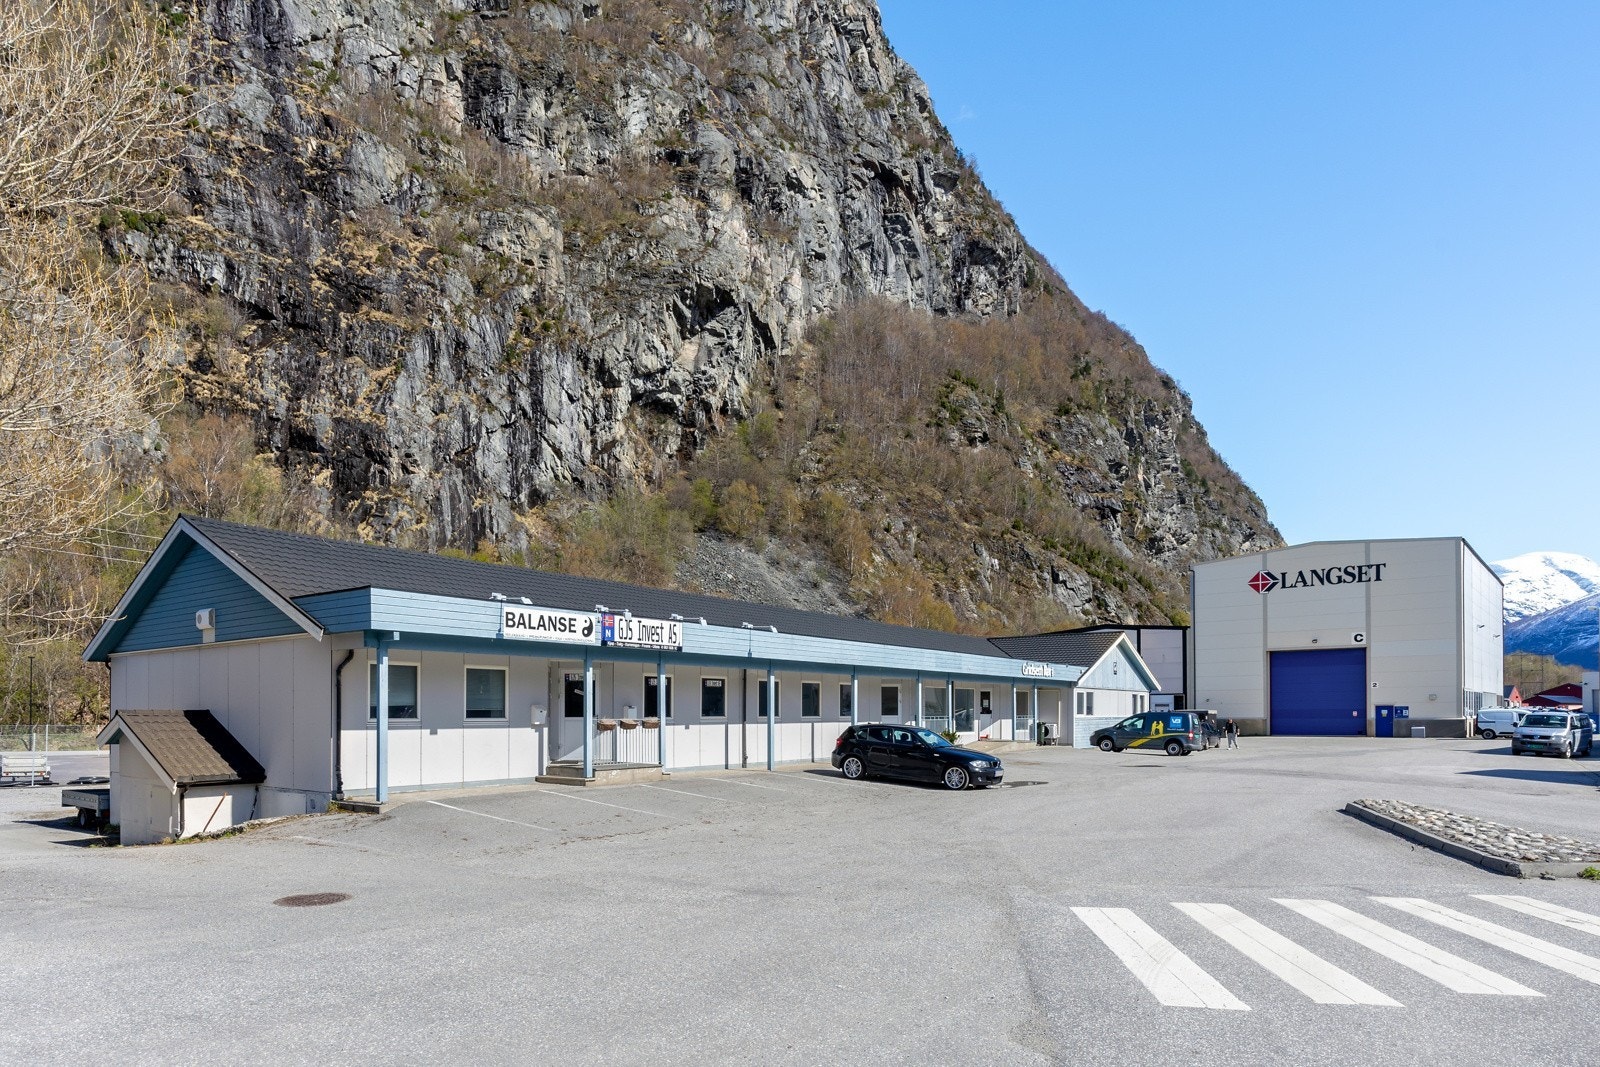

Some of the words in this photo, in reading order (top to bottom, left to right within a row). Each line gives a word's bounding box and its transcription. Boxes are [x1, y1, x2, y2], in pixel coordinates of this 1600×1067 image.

[1280, 563, 1386, 589] LANGSET
[505, 611, 577, 633] BALANSE
[606, 629, 611, 637] N
[637, 620, 664, 642] Invest
[668, 623, 677, 644] AS
[1353, 633, 1364, 643] C
